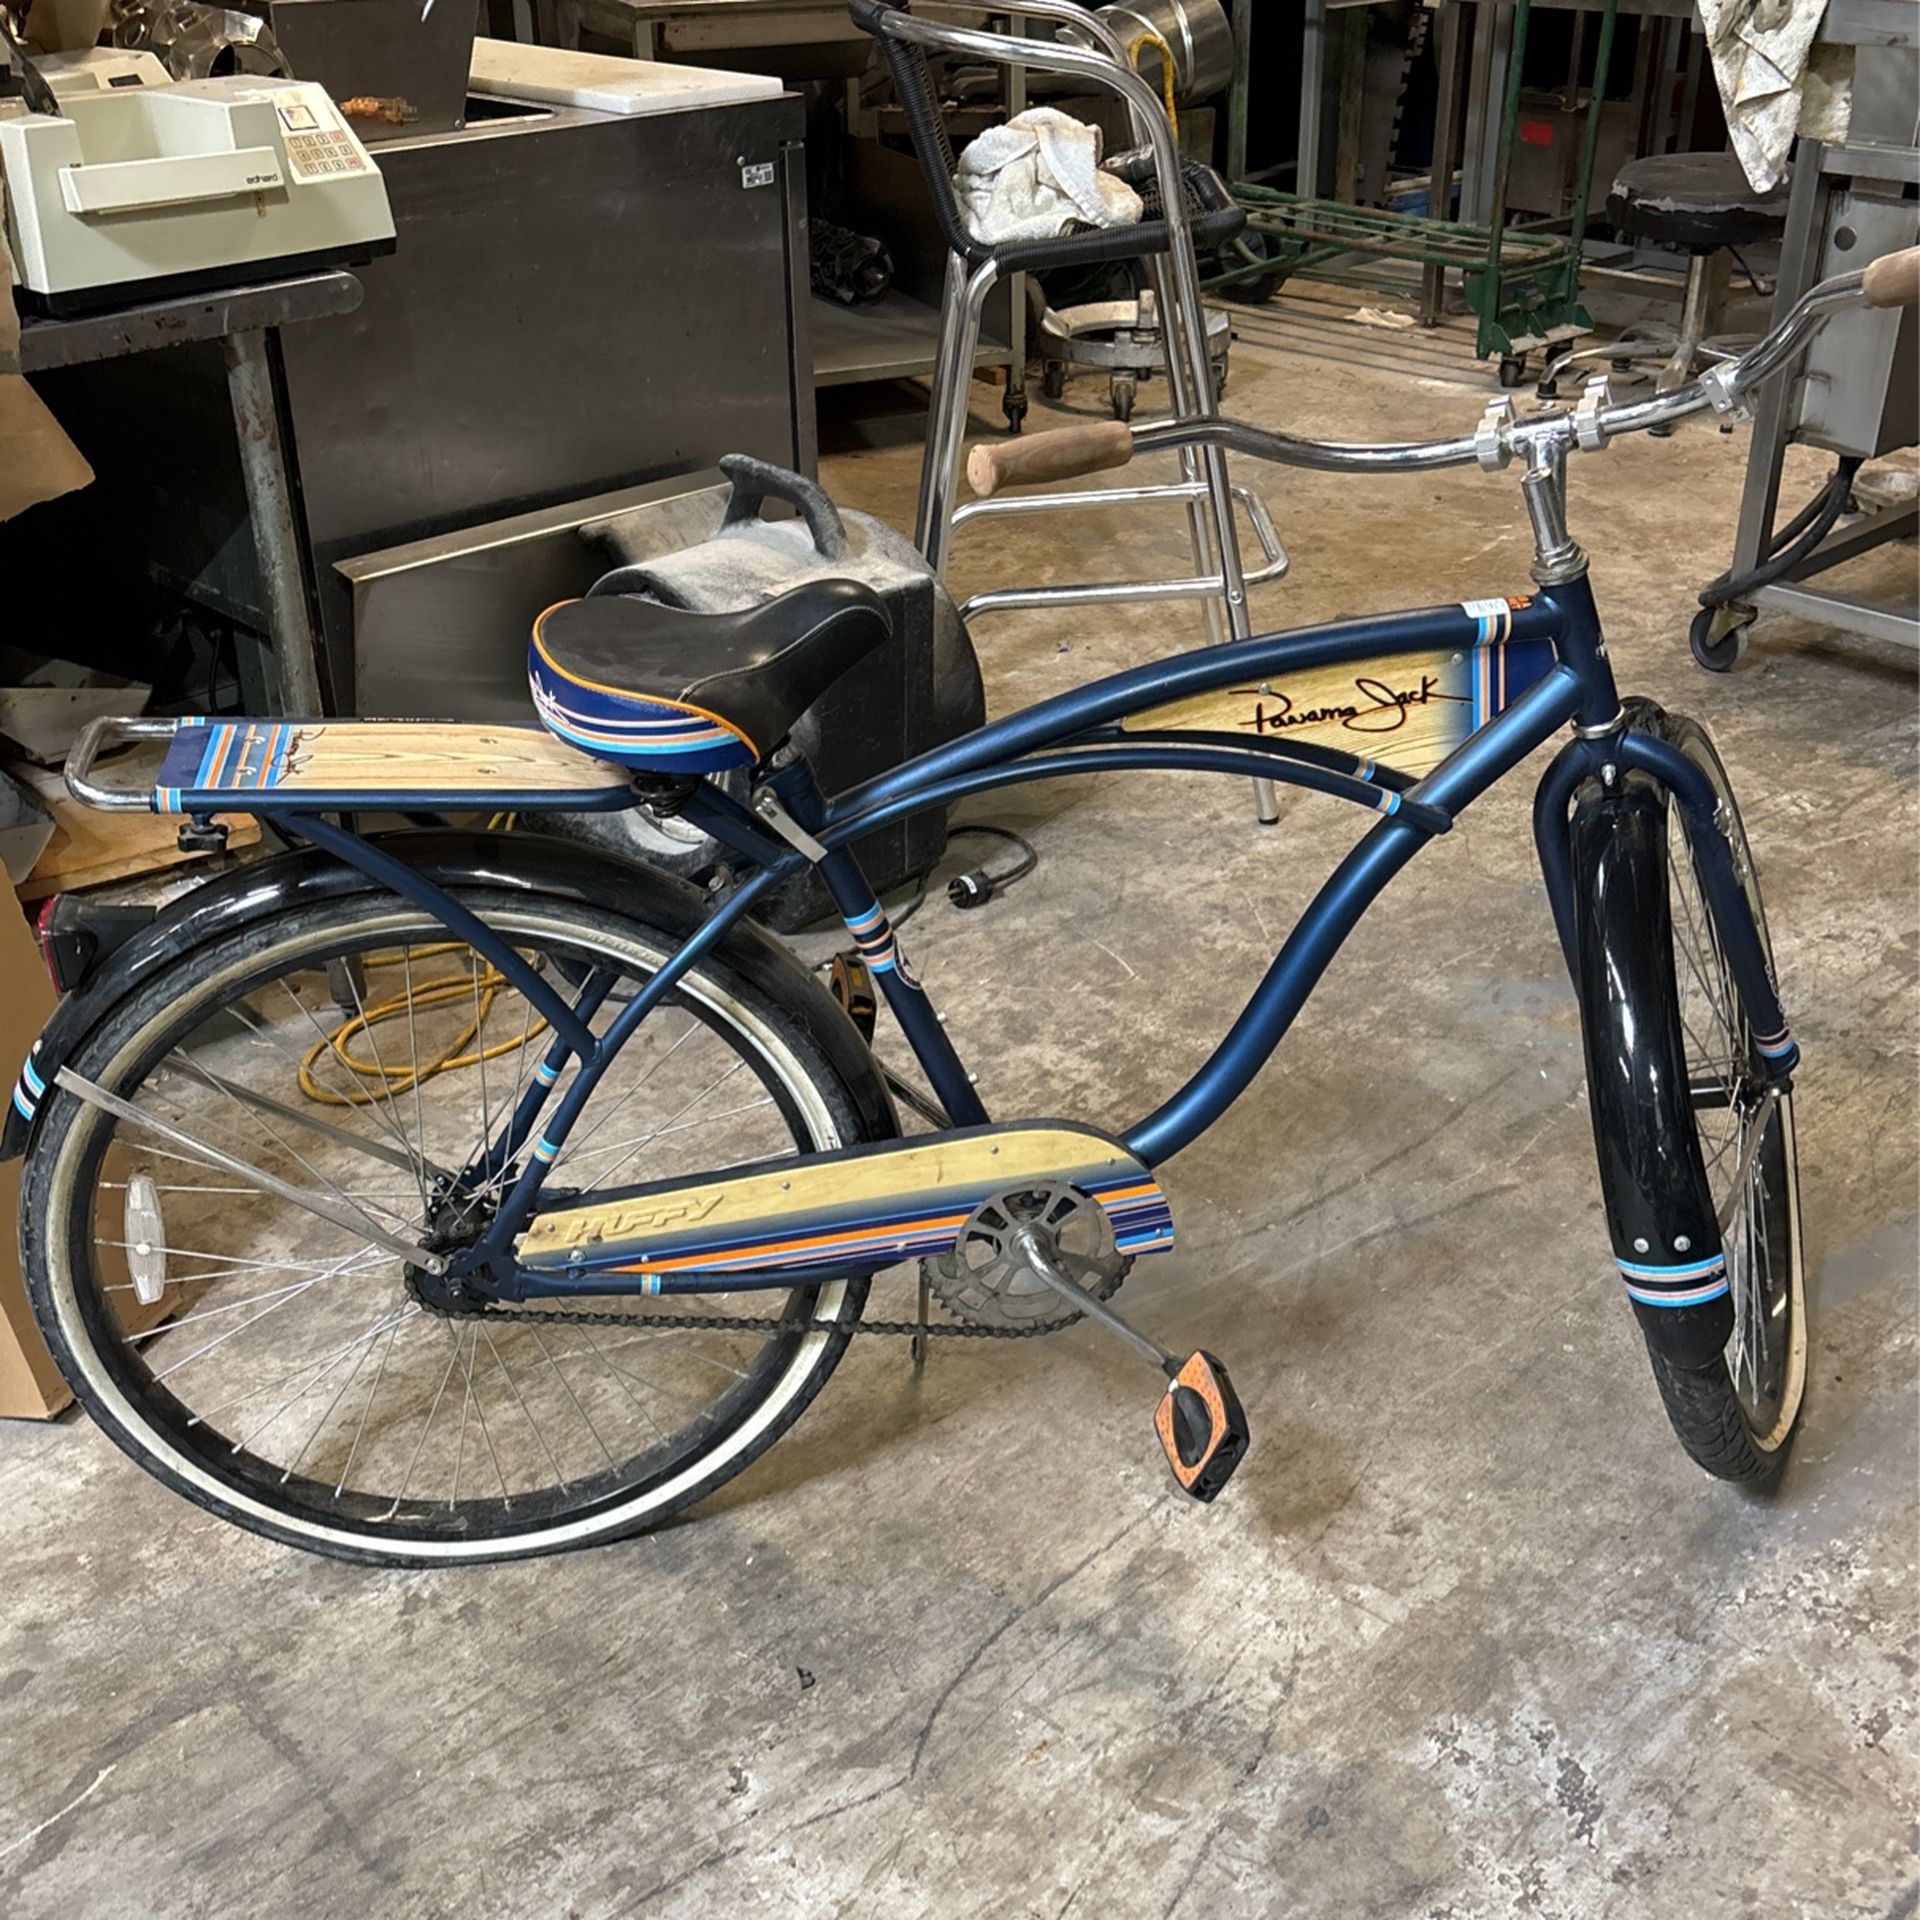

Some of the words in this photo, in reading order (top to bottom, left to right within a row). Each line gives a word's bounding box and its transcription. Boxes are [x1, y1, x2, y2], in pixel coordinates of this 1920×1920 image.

[1228, 689, 1359, 734] Panama
[1342, 675, 1473, 732] Jack
[564, 1194, 724, 1242] HUFFY
